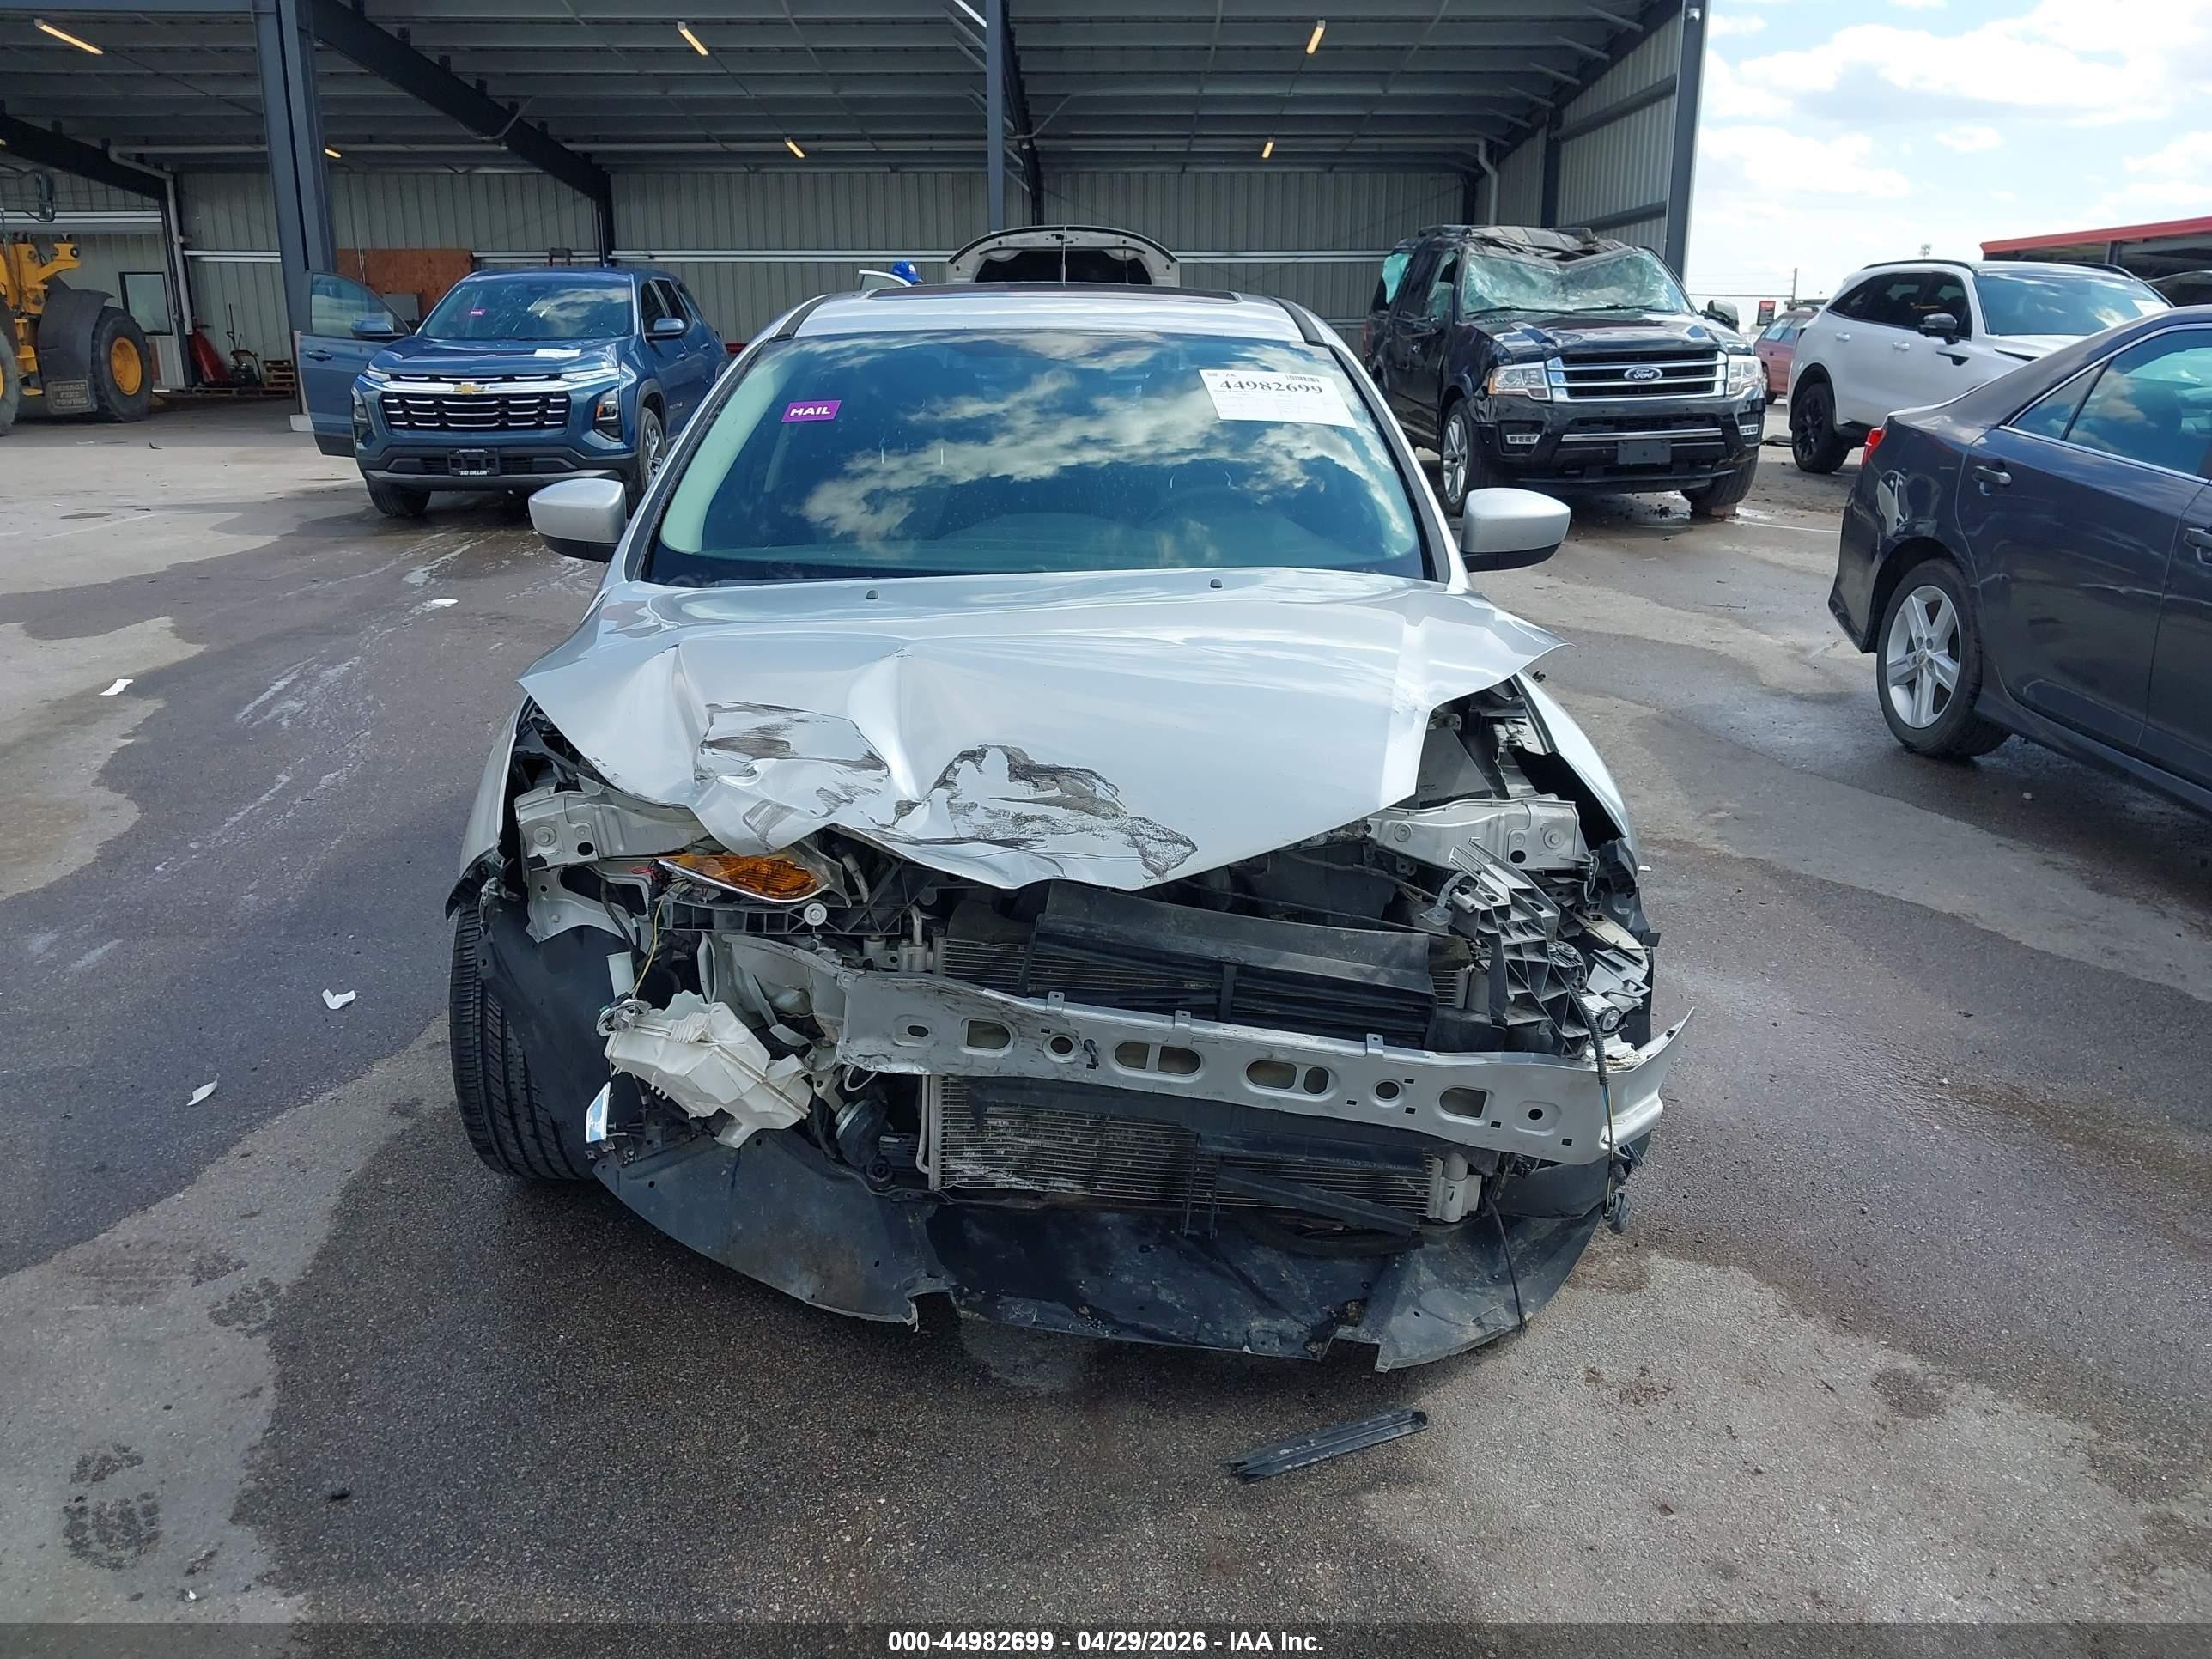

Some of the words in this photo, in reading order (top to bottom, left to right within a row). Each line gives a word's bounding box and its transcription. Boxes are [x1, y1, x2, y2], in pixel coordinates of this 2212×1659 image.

[1633, 369, 1654, 379] Ford
[1219, 380, 1323, 394] 44982699
[789, 406, 831, 416] HAIL
